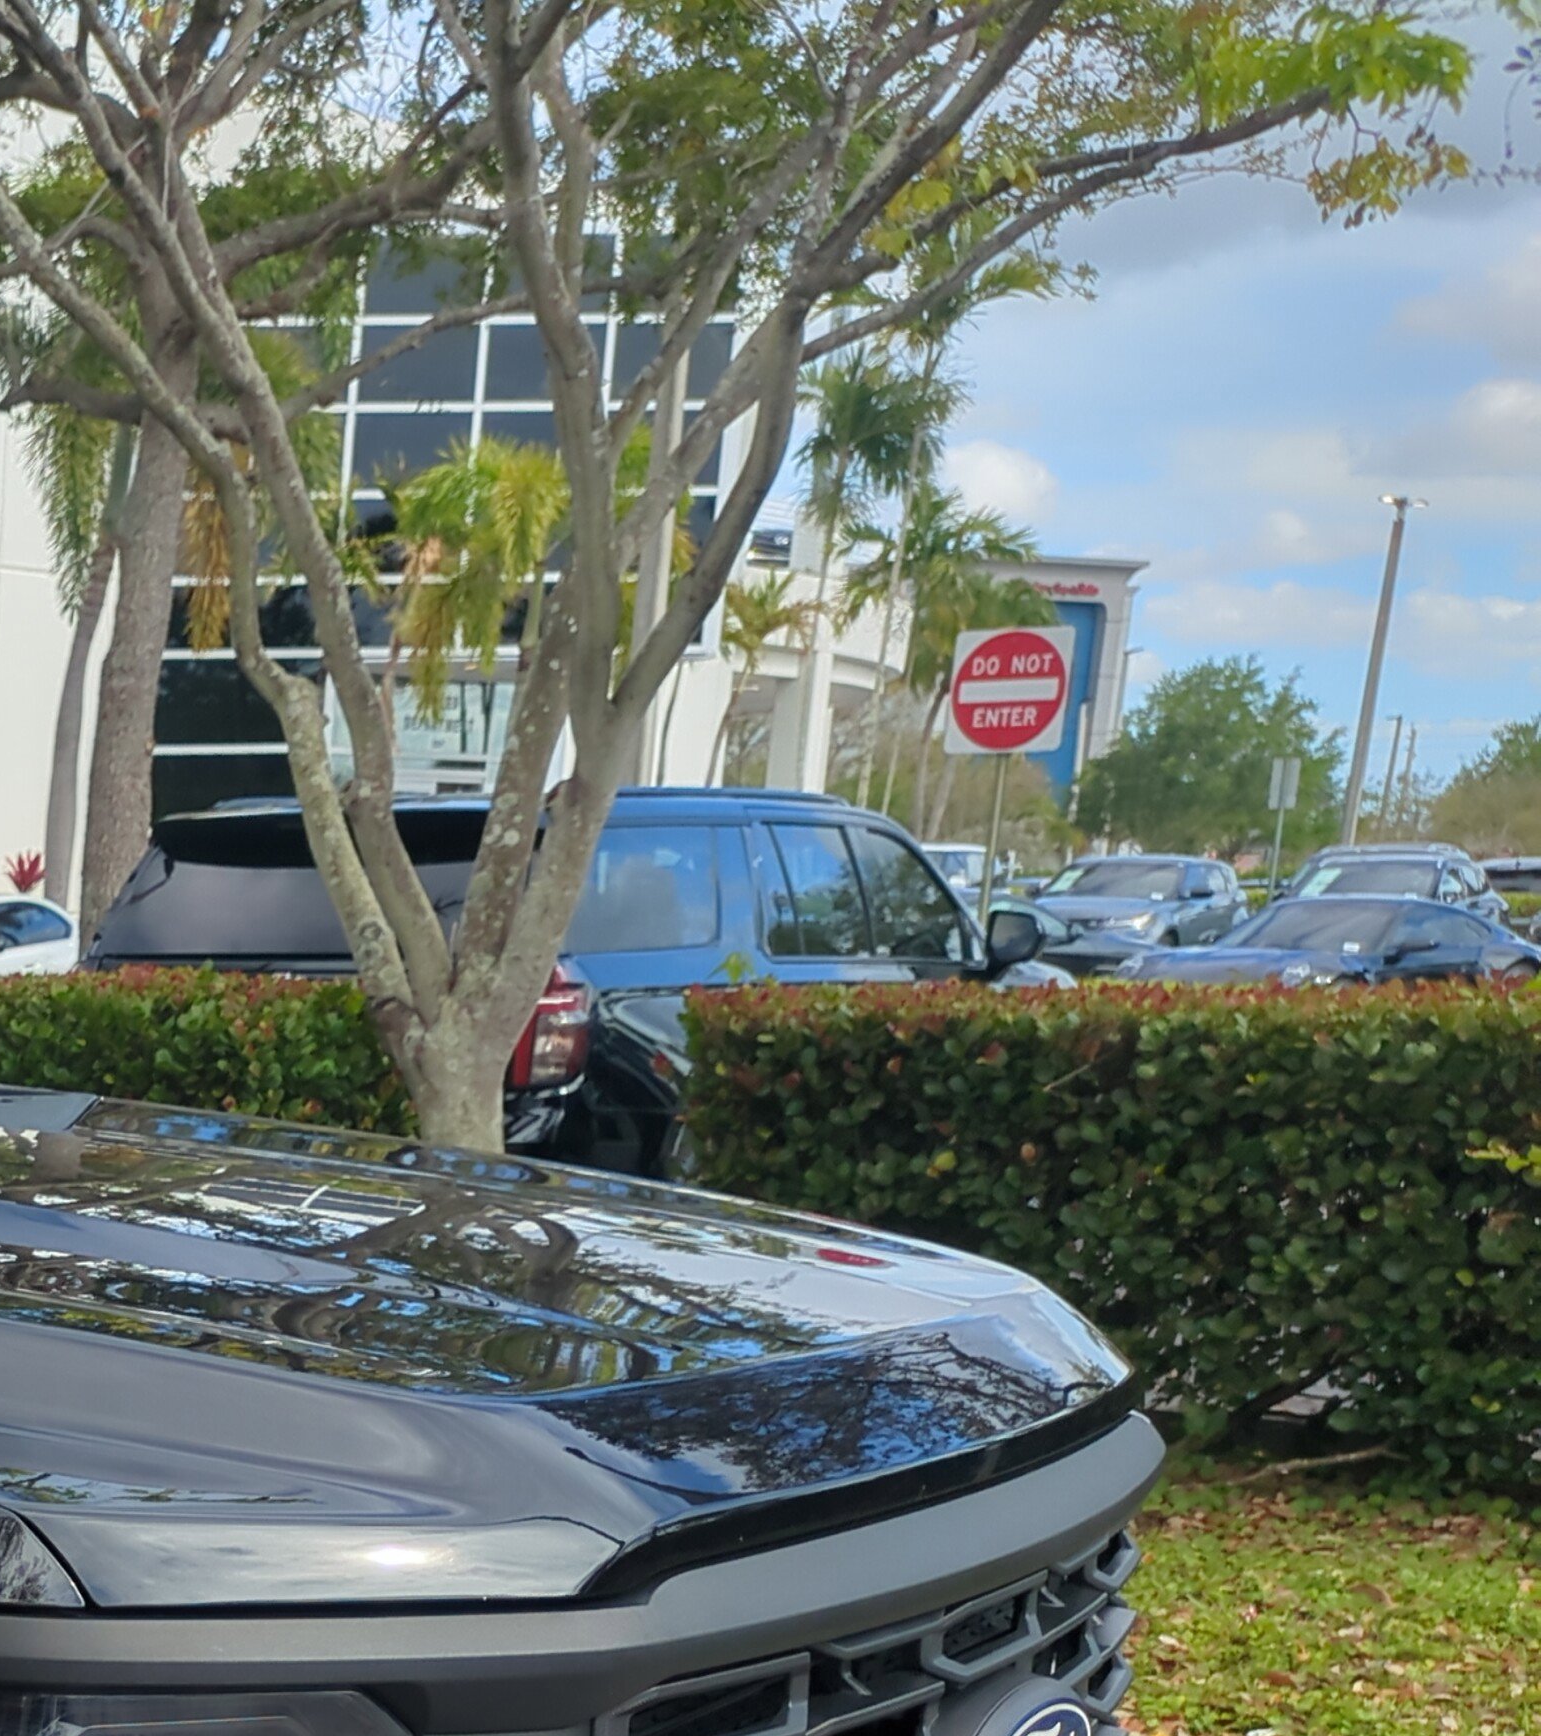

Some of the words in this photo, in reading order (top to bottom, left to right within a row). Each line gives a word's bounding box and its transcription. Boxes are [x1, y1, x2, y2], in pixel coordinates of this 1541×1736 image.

[971, 655, 1000, 677] DO
[1011, 653, 1053, 674] NOT
[971, 706, 1038, 729] ENTER
